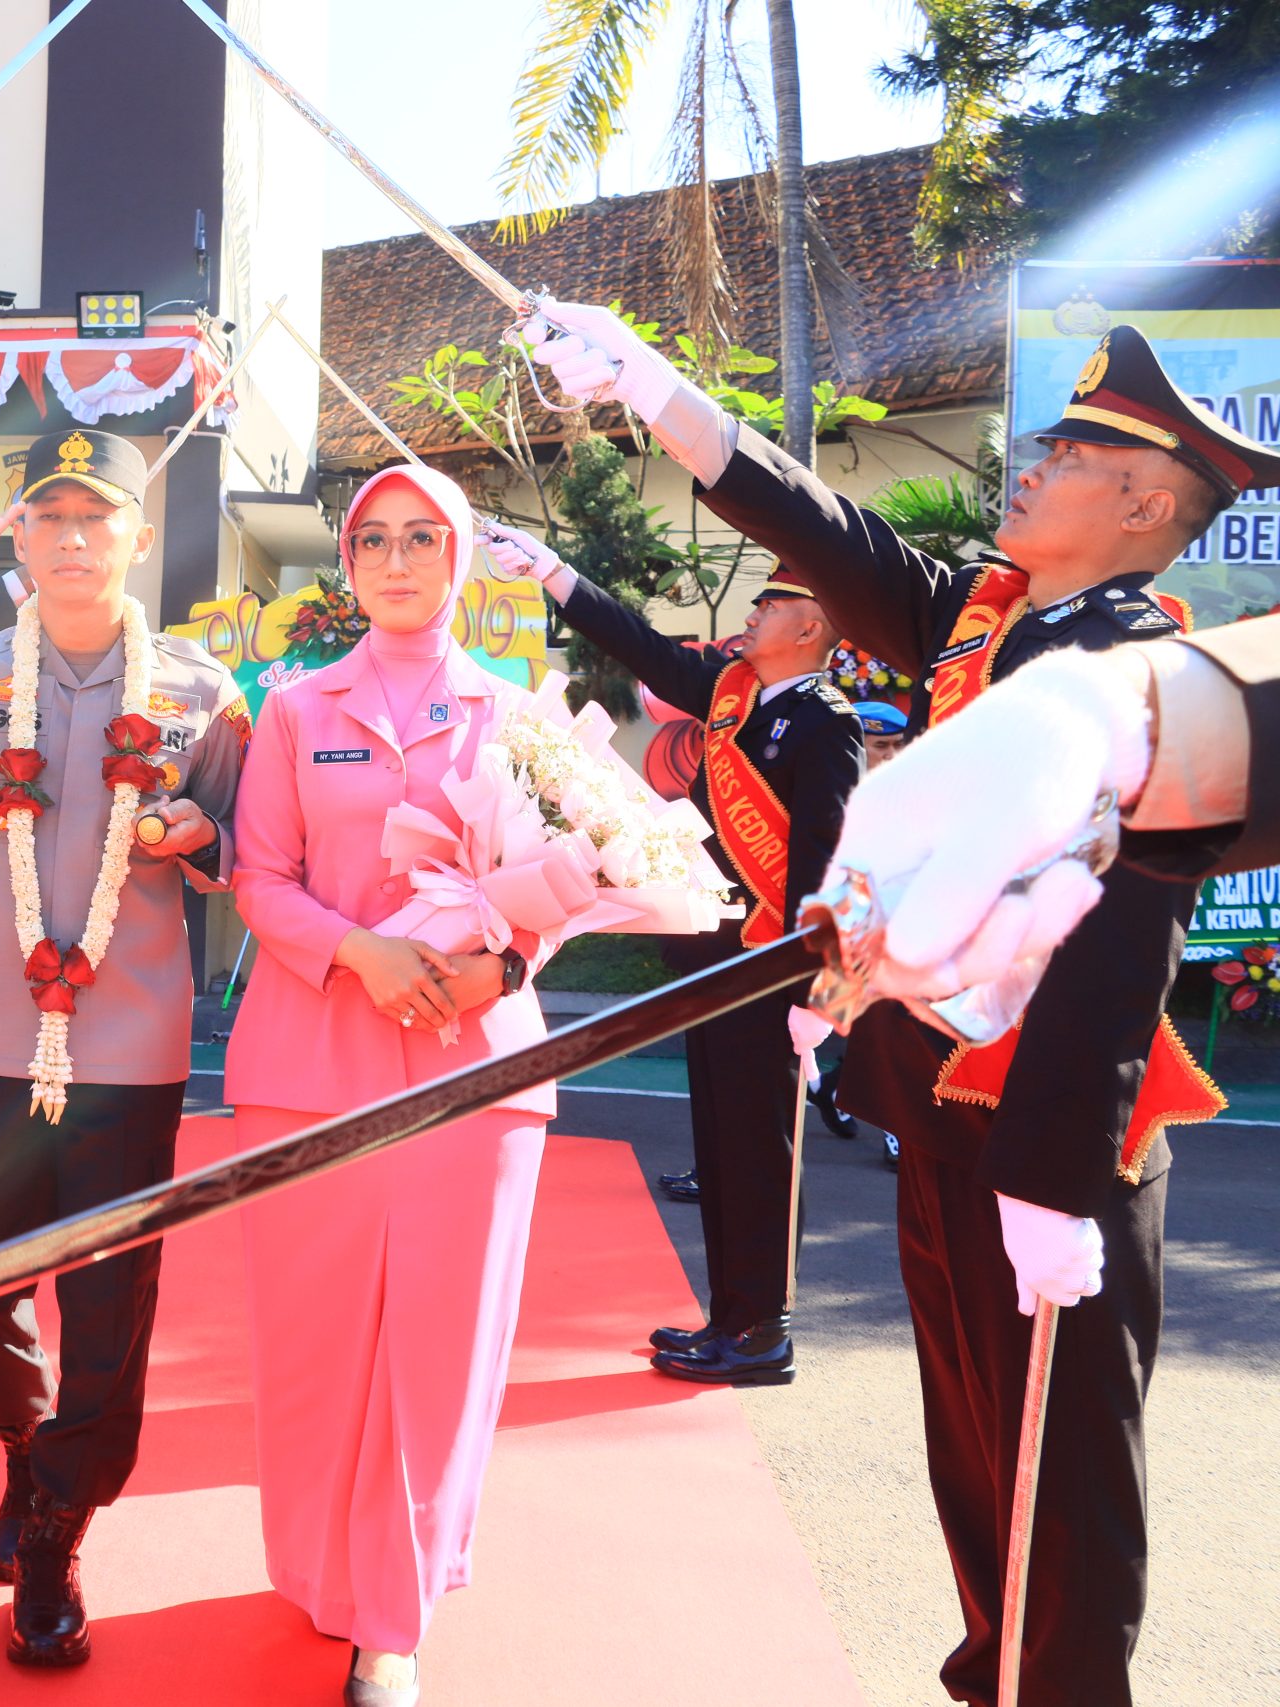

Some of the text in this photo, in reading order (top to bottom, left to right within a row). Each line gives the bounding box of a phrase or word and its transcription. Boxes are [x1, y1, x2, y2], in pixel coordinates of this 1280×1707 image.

[938, 646, 962, 660] SUGENG
[725, 795, 786, 872] KEDIRI
[1206, 908, 1263, 930] KETUA
